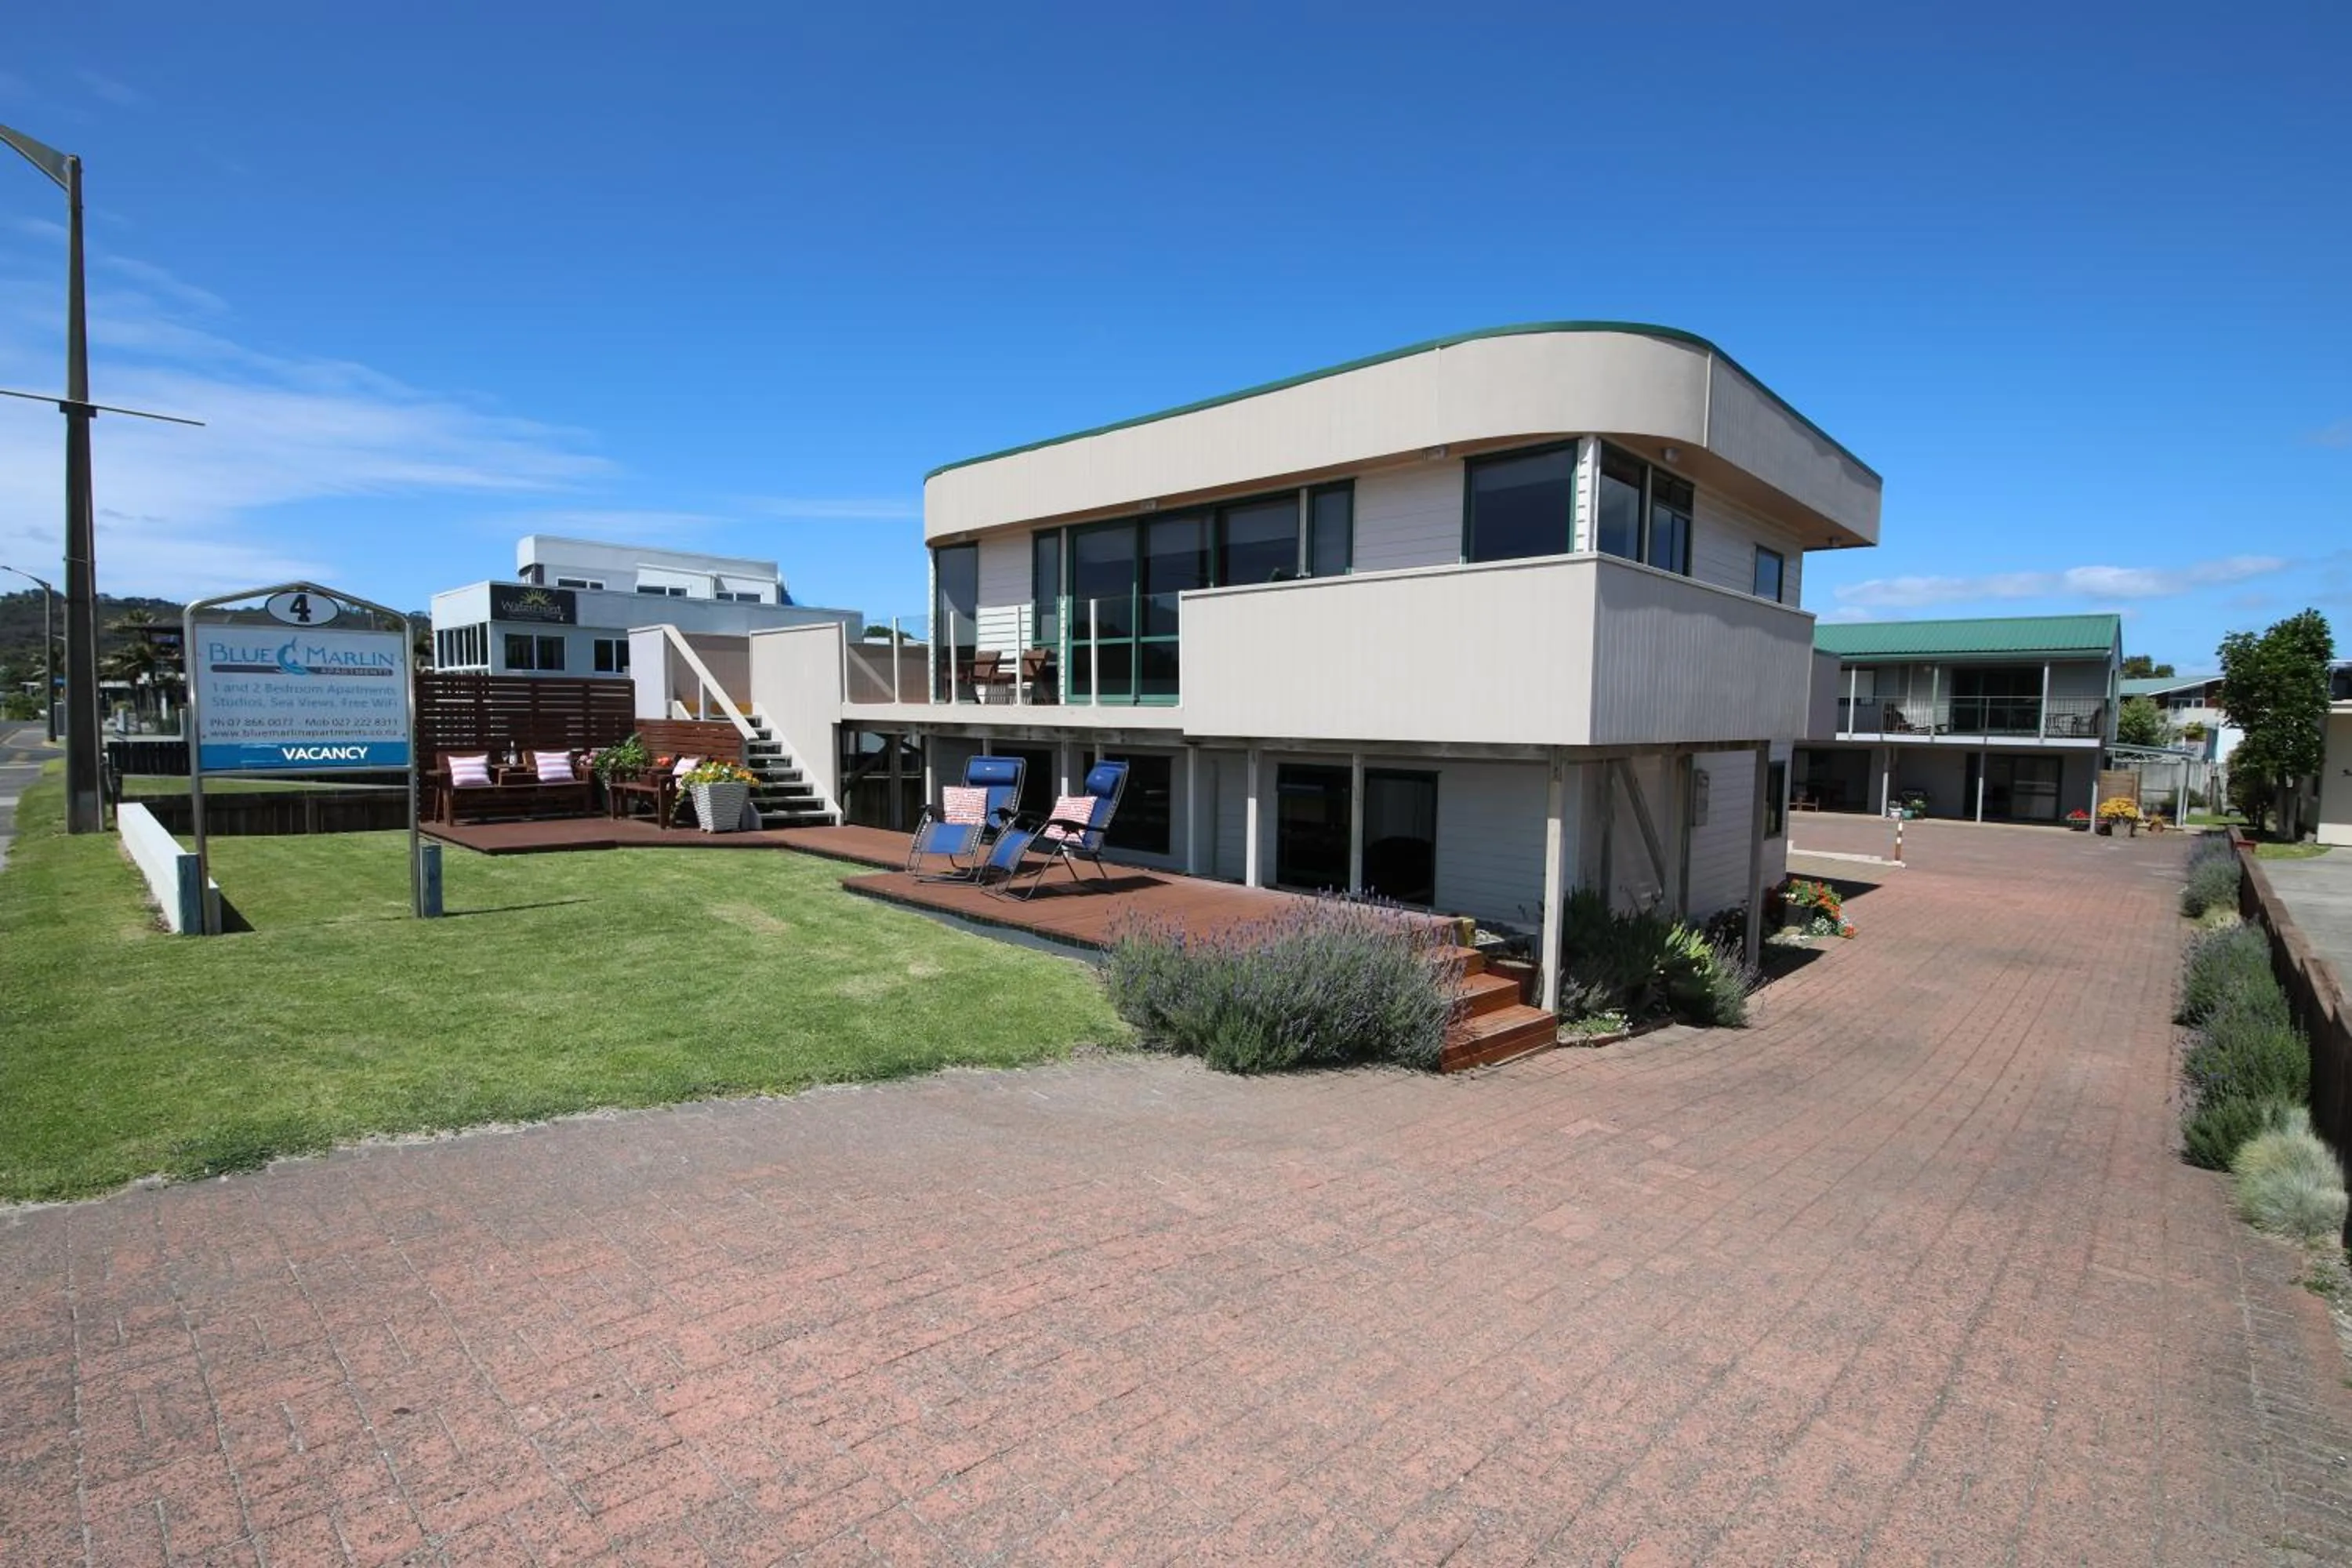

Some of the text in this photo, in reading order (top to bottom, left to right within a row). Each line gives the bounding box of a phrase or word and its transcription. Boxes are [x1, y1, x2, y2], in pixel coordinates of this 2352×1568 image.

[289, 593, 311, 622] 4
[209, 642, 394, 666] BLUE MARLIN
[212, 682, 397, 696] 1 and 2 Bedroom Apartments
[270, 697, 294, 707] Sea
[342, 698, 368, 707] Free
[210, 717, 224, 727] Ph
[227, 717, 241, 727] 07
[304, 717, 329, 727] Mob
[332, 717, 350, 727] 027
[354, 717, 371, 727] 222
[281, 746, 368, 761] VACANCY
